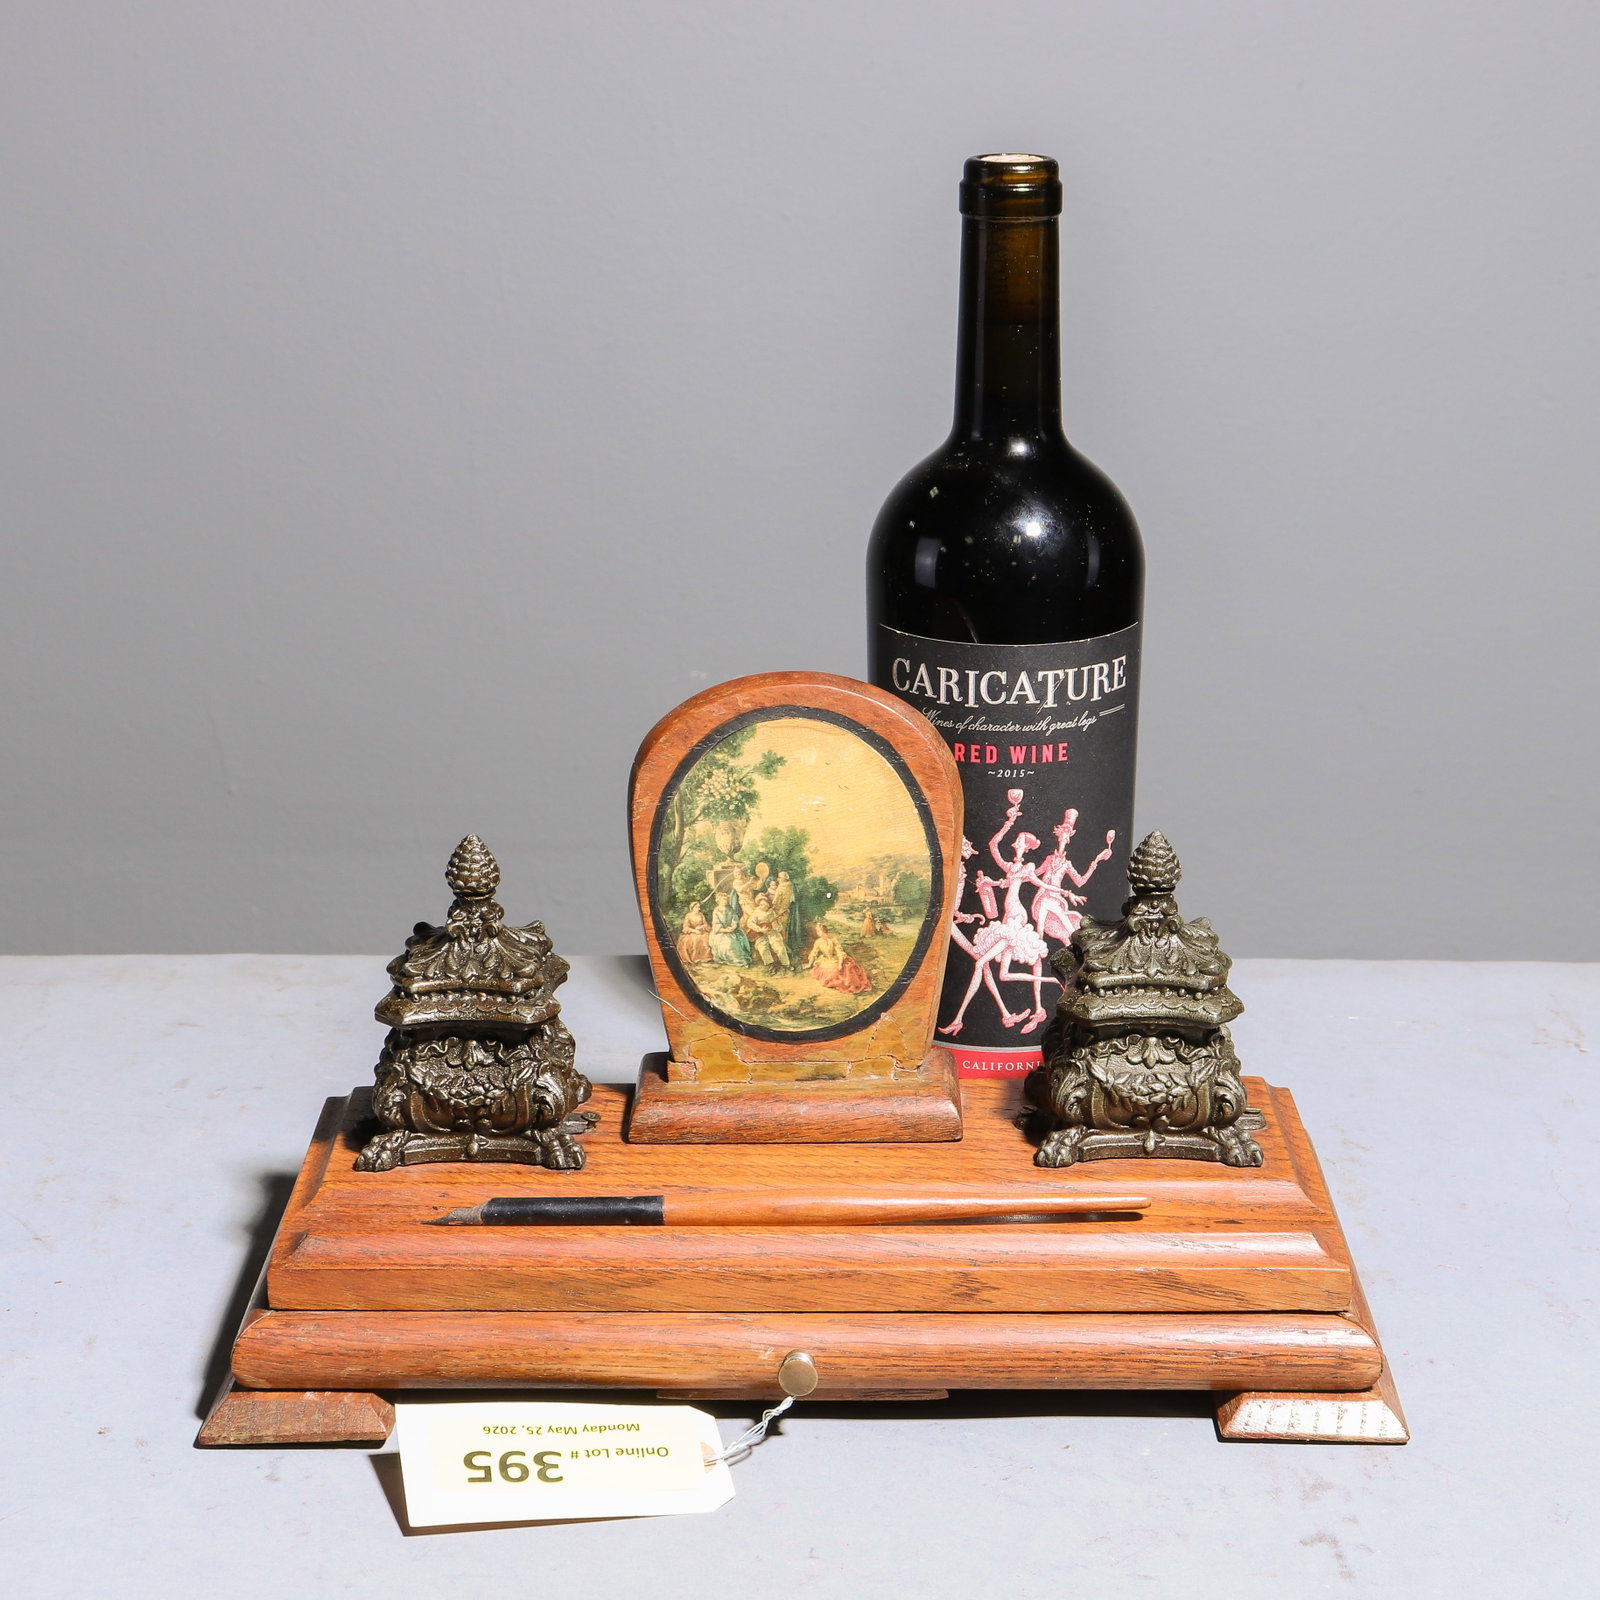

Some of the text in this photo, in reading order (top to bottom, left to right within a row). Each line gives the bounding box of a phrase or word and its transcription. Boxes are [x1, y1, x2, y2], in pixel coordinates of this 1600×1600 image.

[892, 655, 1126, 709] CARICATURE
[955, 715, 972, 735] of
[968, 716, 1021, 733] character
[1022, 716, 1047, 732] with
[1046, 715, 1077, 736] great
[1076, 711, 1097, 732] legs
[954, 742, 1068, 764] RED WINE
[483, 1423, 640, 1435] Monday May 25, 2026
[463, 1446, 669, 1483] Online Lot # 395
